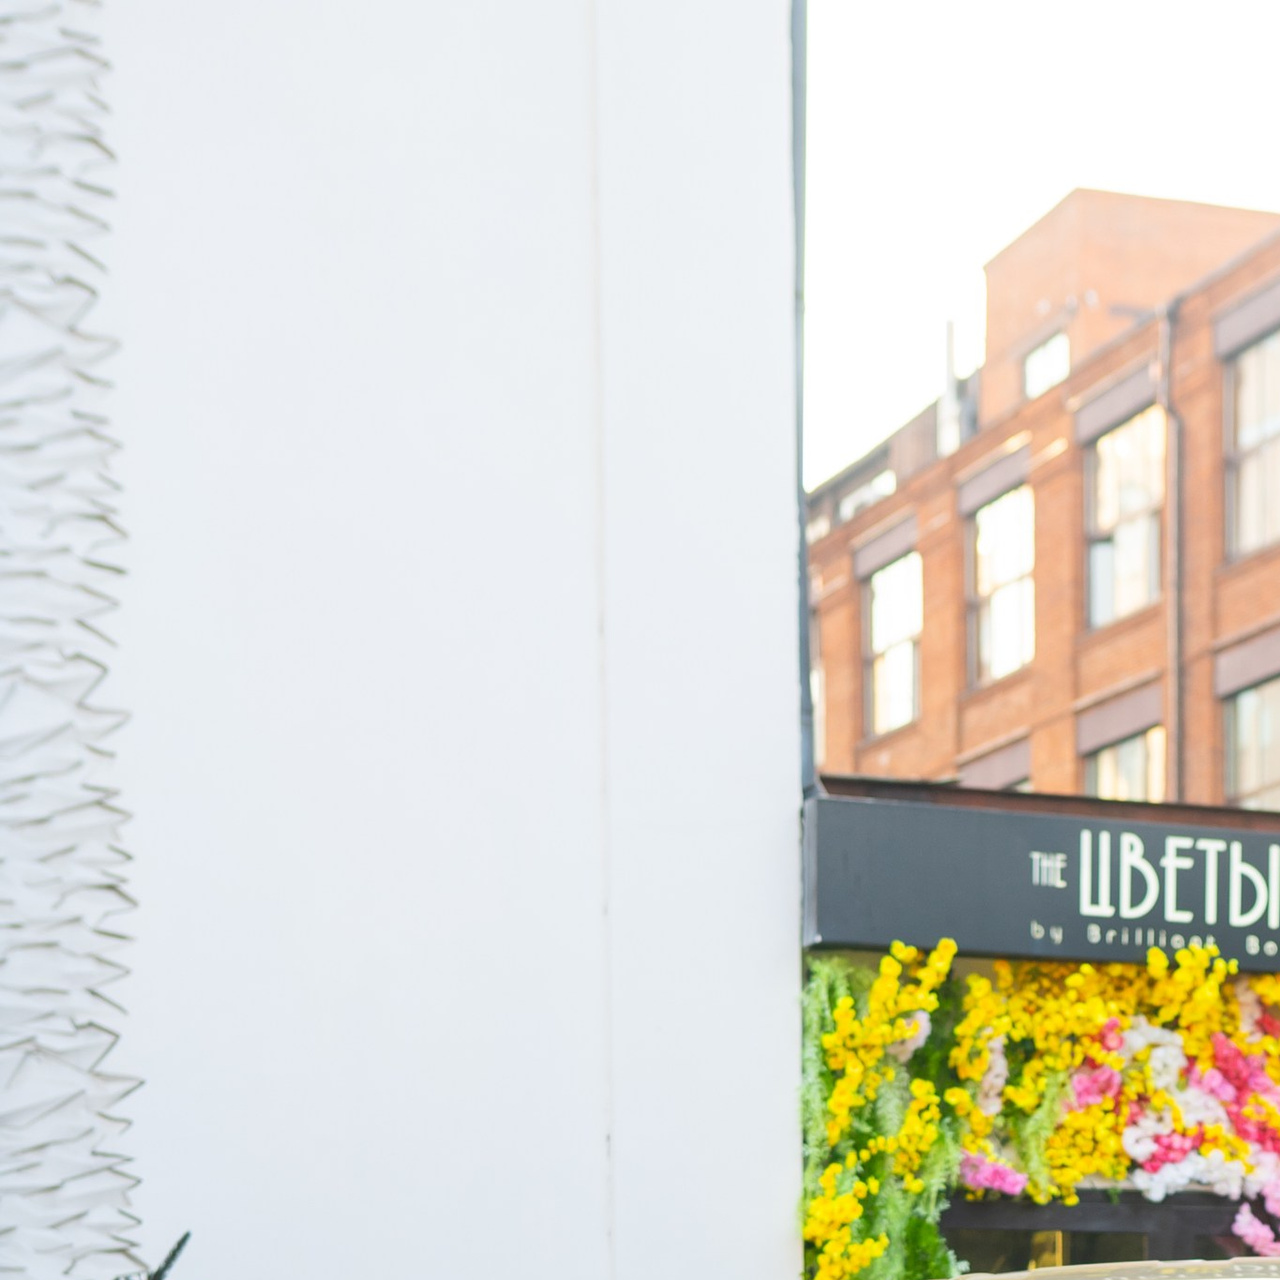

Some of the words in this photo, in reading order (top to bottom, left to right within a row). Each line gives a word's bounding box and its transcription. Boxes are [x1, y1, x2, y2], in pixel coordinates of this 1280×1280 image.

[1029, 850, 1067, 888] THE
[1079, 829, 1280, 929] ЦВЕТЫ
[1030, 920, 1063, 945] by
